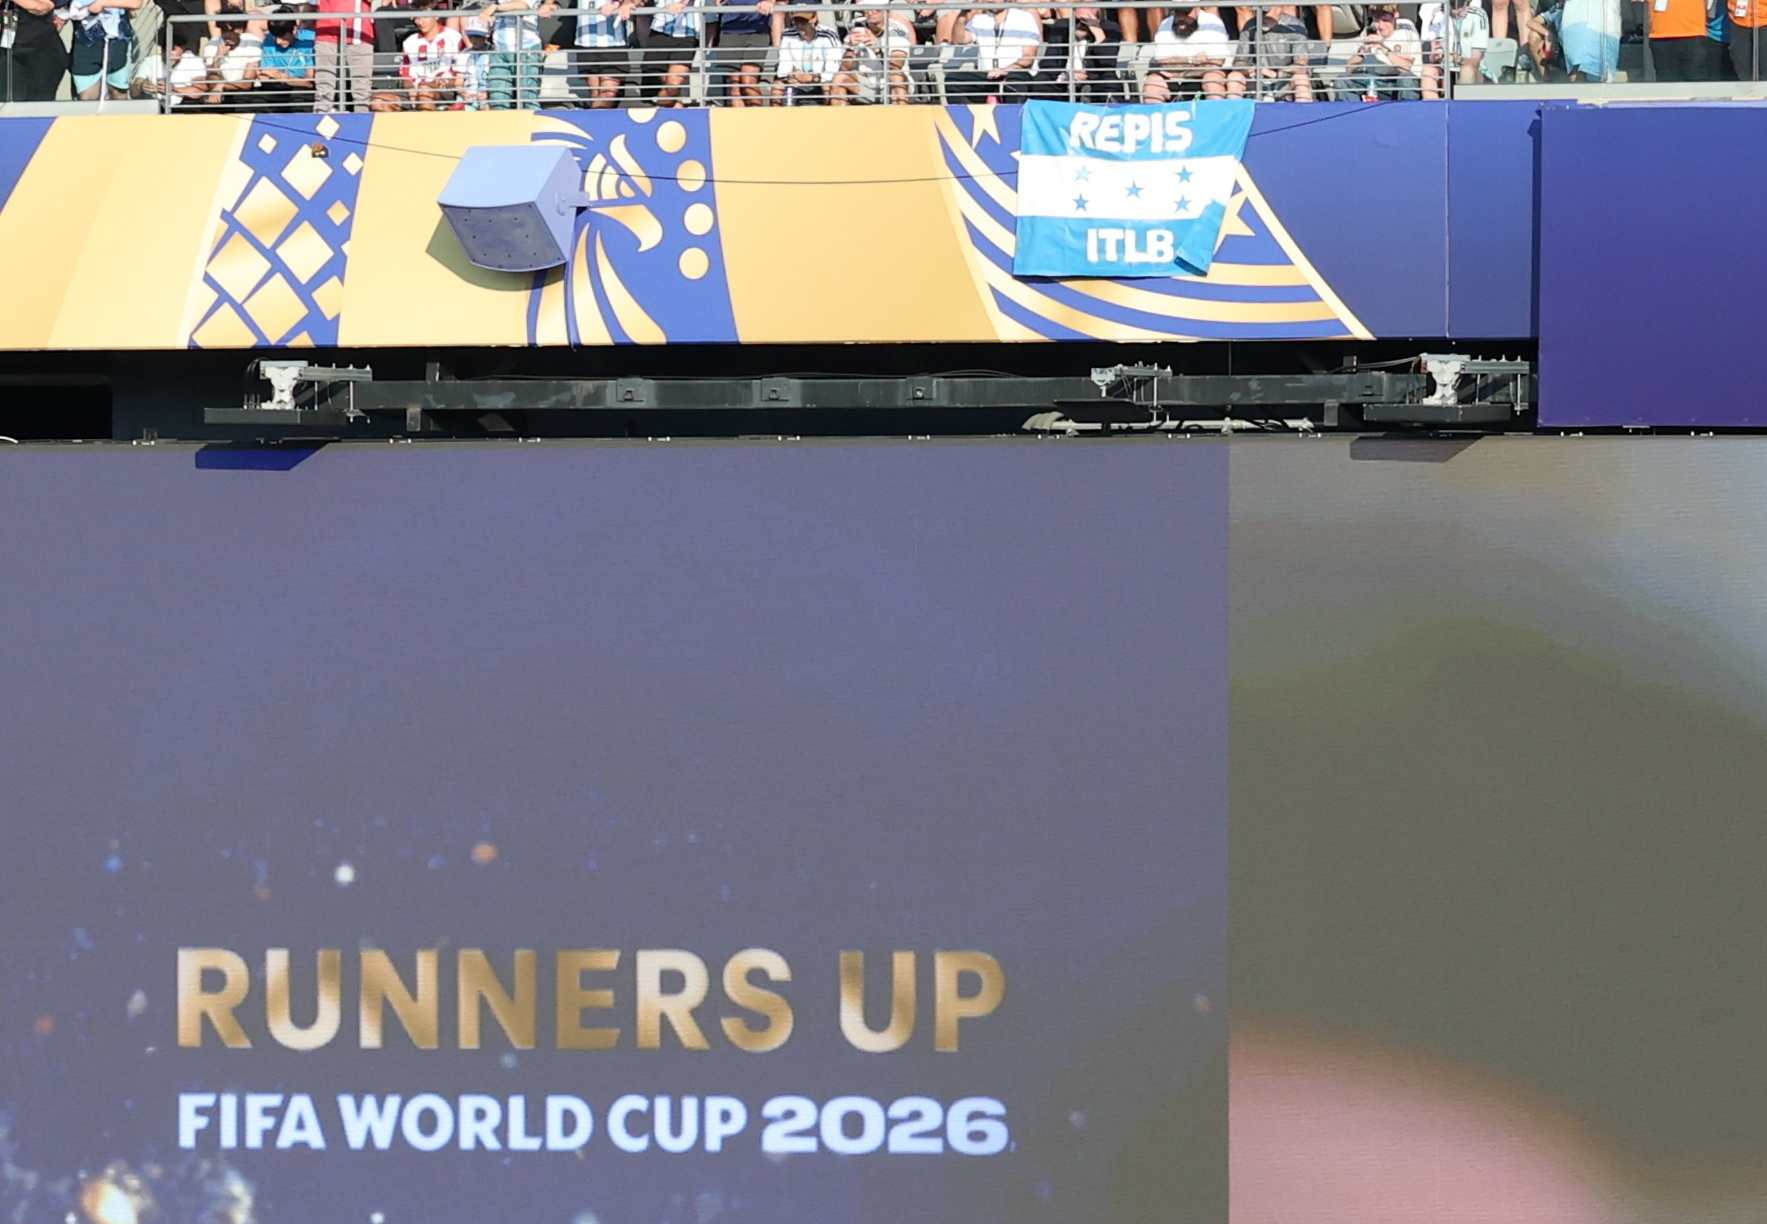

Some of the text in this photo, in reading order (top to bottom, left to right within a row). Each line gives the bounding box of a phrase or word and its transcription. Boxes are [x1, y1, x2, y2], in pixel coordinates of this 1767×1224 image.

[1069, 110, 1192, 153] REPIS
[1086, 227, 1174, 264] ITLB
[176, 947, 1007, 1052] RUNNERS UP
[178, 1093, 1009, 1155] FIFA WORLD CUP 2026
